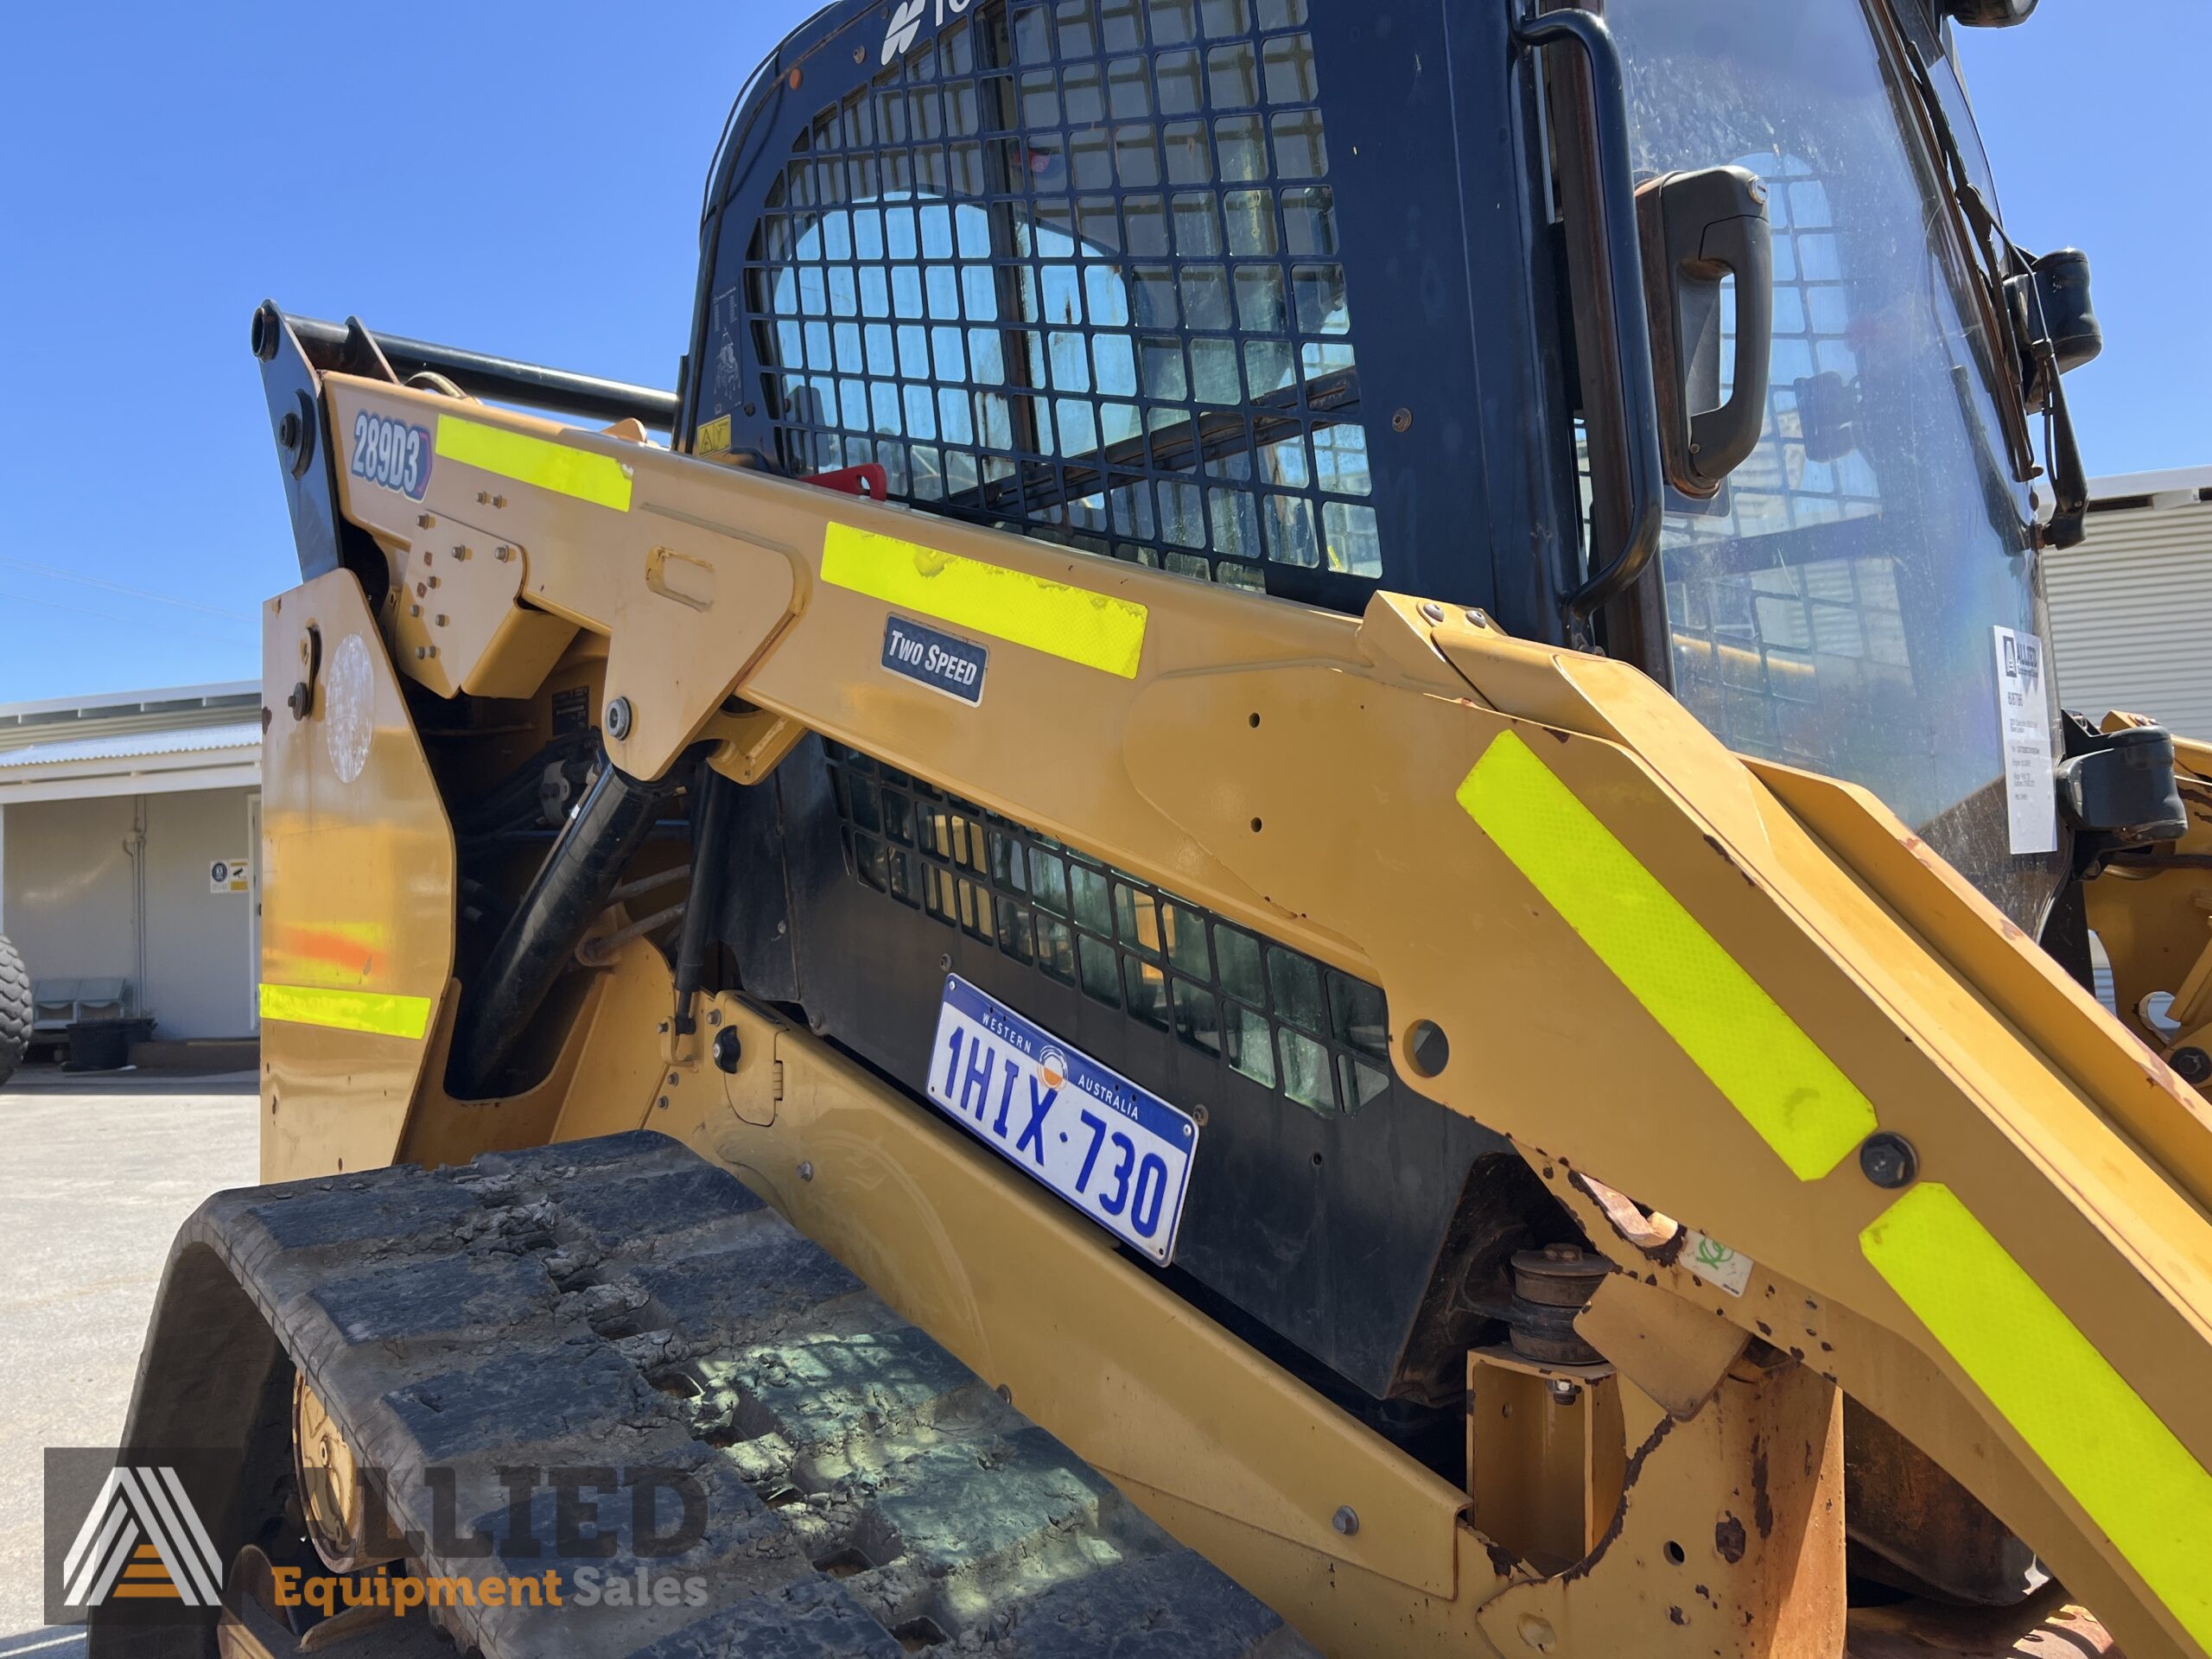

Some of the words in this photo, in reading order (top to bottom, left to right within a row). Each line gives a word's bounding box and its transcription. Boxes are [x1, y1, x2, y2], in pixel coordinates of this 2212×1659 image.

[353, 414, 420, 493] 289D3
[888, 630, 925, 666] TWO
[925, 644, 977, 686] SPEED
[982, 1012, 1032, 1053] WESTERN
[1077, 1073, 1139, 1121] AUSTRALIA
